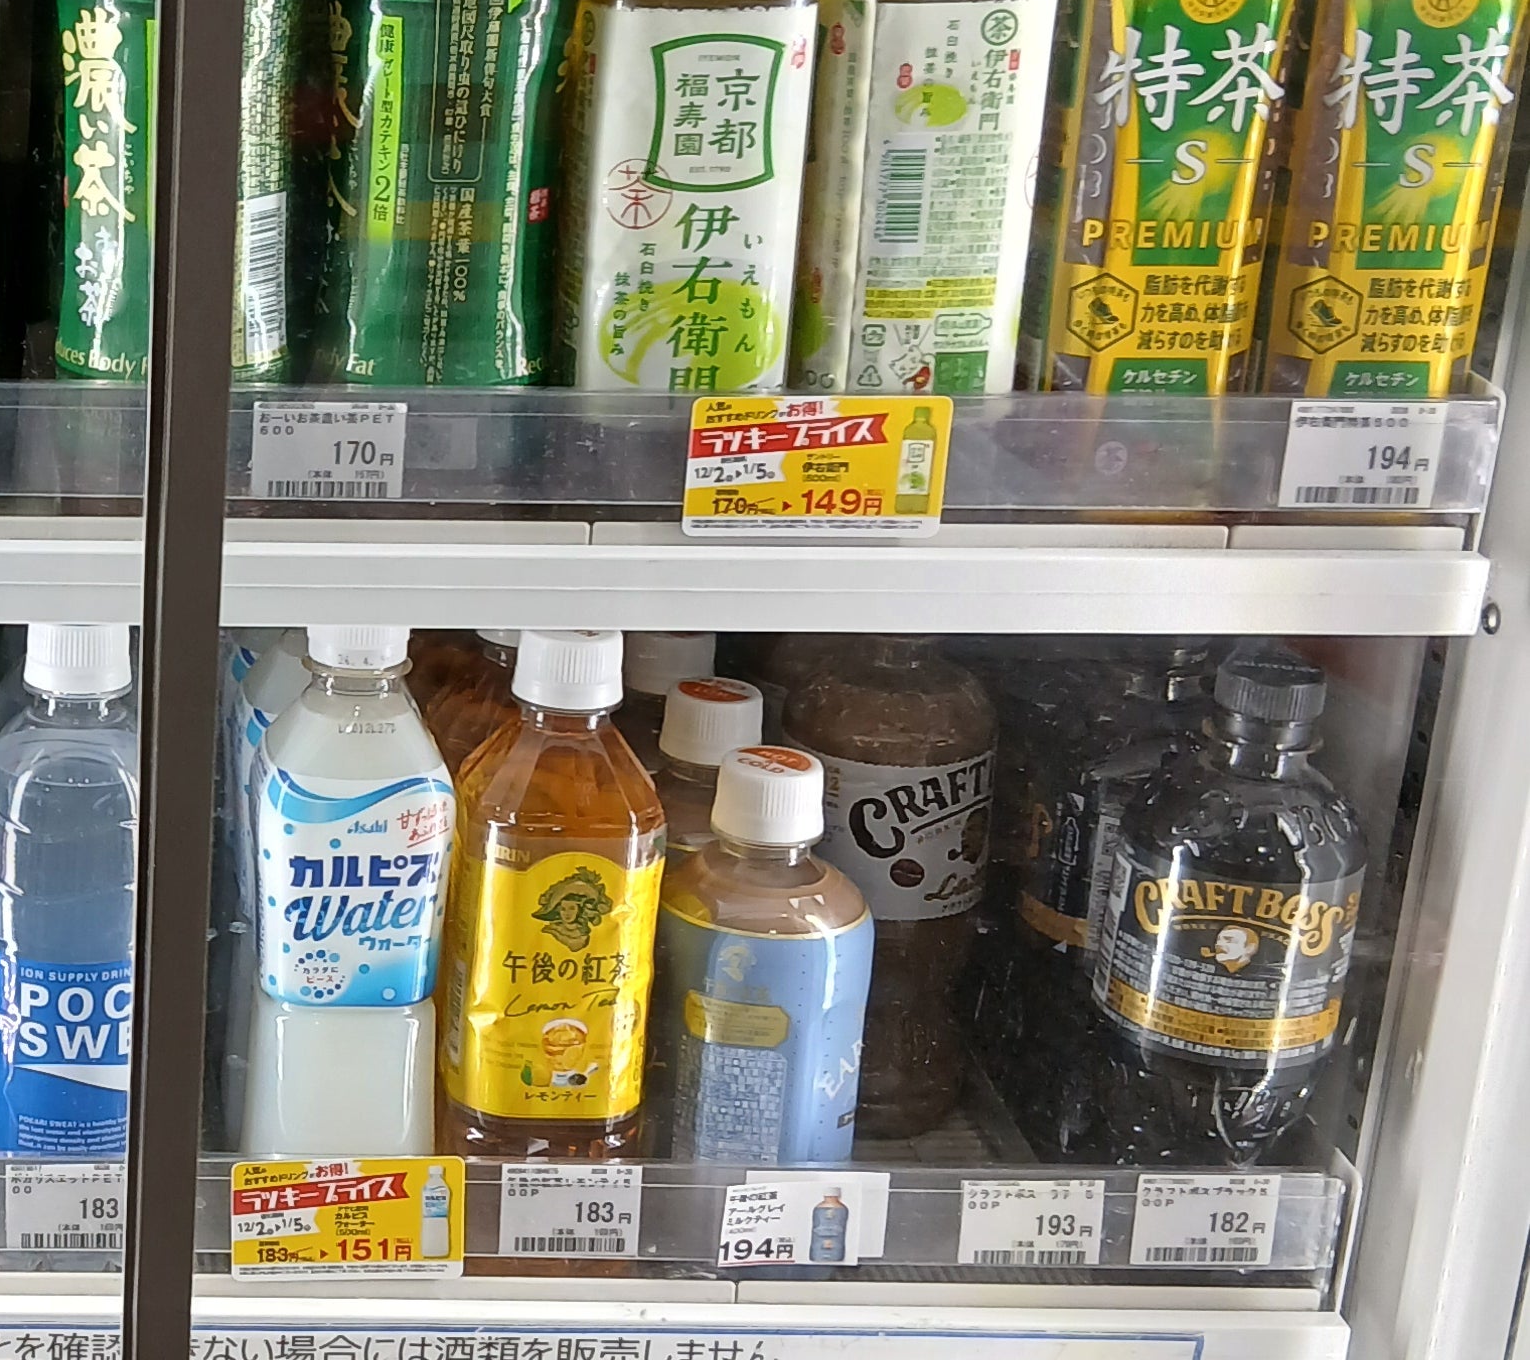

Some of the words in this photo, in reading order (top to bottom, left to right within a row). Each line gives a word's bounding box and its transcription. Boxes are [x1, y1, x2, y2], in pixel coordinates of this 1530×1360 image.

[1094, 23, 1284, 132] 特茶
[1325, 27, 1515, 136] 特茶
[673, 72, 710, 157] 福寿園
[708, 67, 761, 160] 京都
[1171, 140, 1208, 185] S
[1399, 143, 1436, 189] S
[1081, 217, 1265, 251] PREMIUM
[1309, 220, 1491, 254] PREMIUM
[666, 202, 740, 391] 伊右衛門
[734, 234, 764, 355] いえもん
[1122, 368, 1198, 388] ケルセチン
[700, 418, 874, 453] ラッキープライス
[849, 761, 989, 859] CRAFT
[289, 853, 439, 888] カルピス
[284, 890, 438, 941] Water
[1134, 878, 1253, 935] CRAFT
[1255, 890, 1344, 957] BOSS
[20, 967, 44, 980] ION
[48, 971, 98, 982] SUPPLY
[502, 949, 634, 987] 午後の紅茶
[20, 982, 133, 1023] POC
[19, 1022, 131, 1060] SWE
[241, 1178, 396, 1210] ラッキープライス
